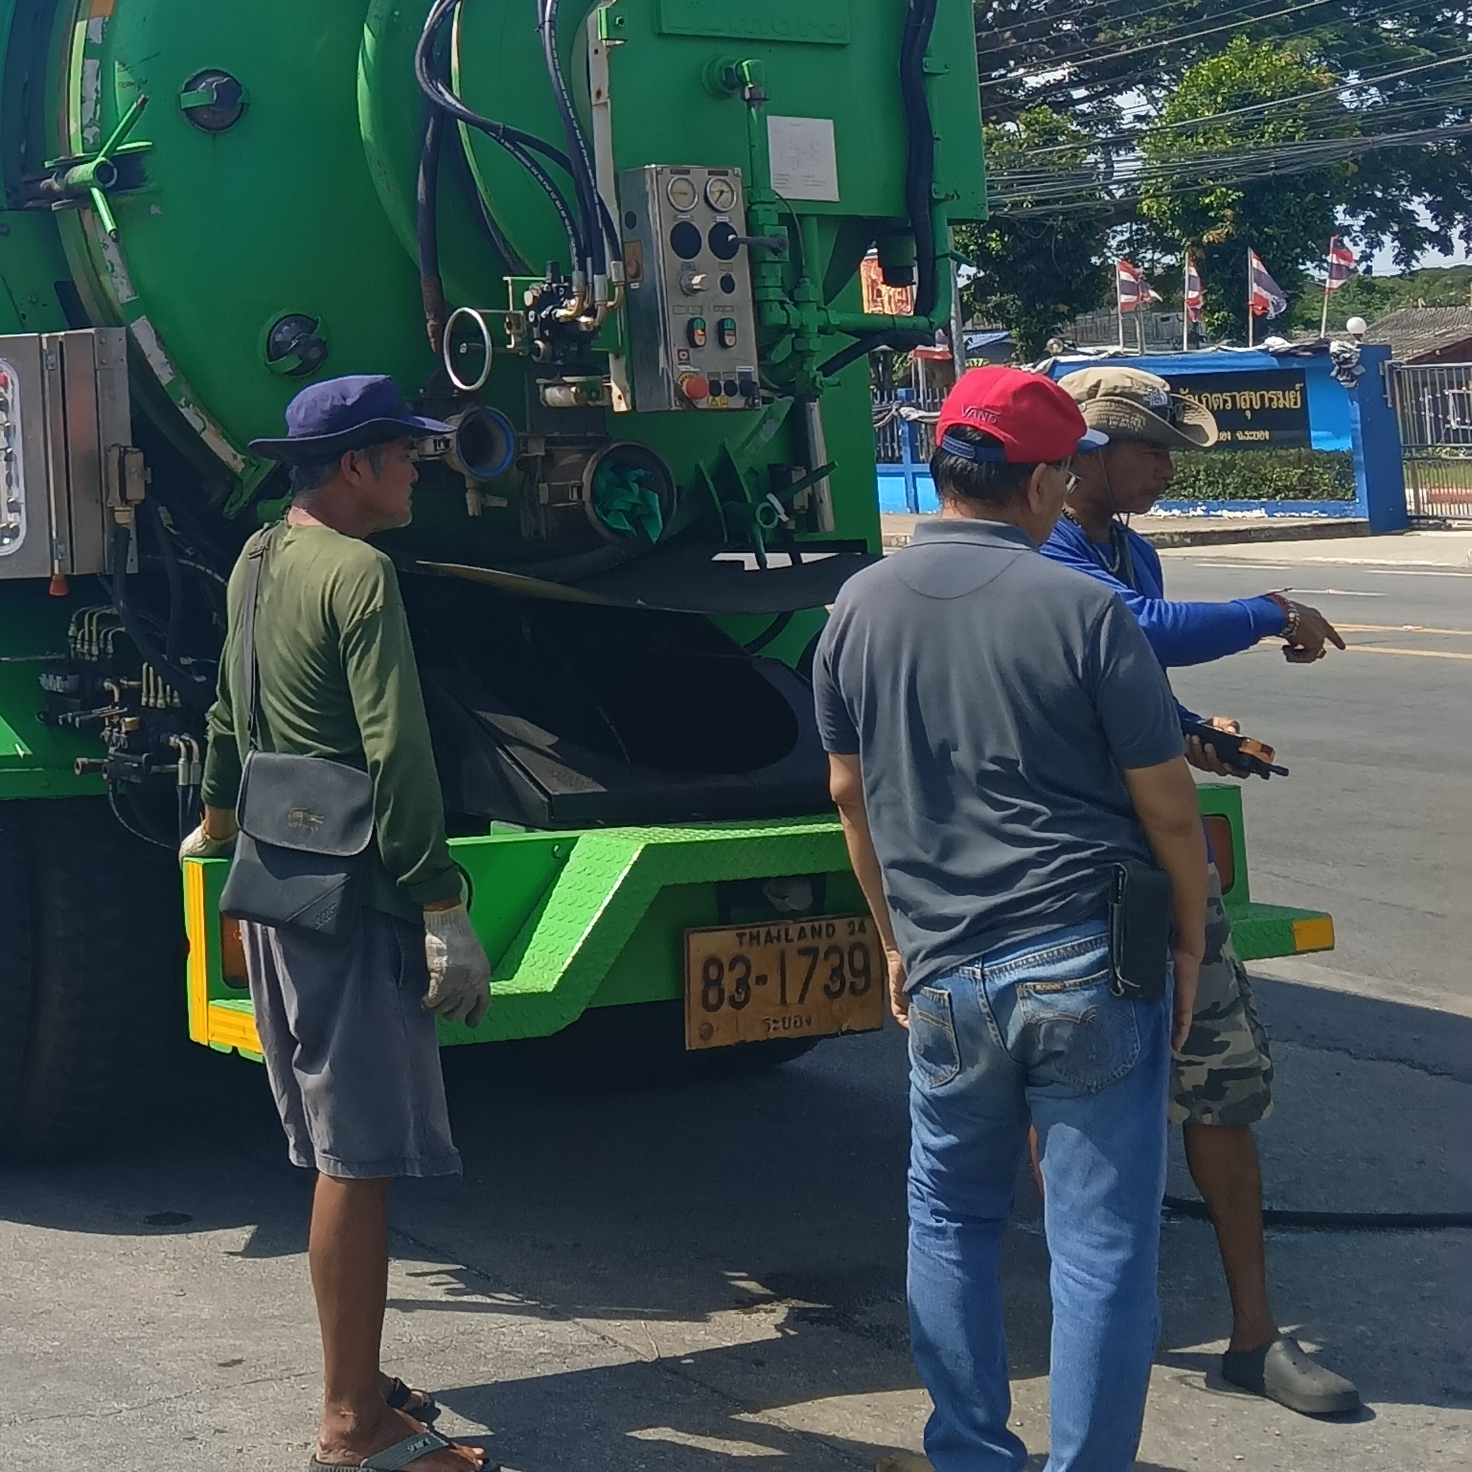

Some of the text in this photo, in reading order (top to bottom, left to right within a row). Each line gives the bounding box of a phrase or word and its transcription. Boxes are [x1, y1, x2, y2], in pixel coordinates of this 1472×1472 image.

[735, 922, 836, 948] THAILAND
[700, 941, 872, 1013] 83-1739
[762, 1014, 813, 1032] ระยอง
